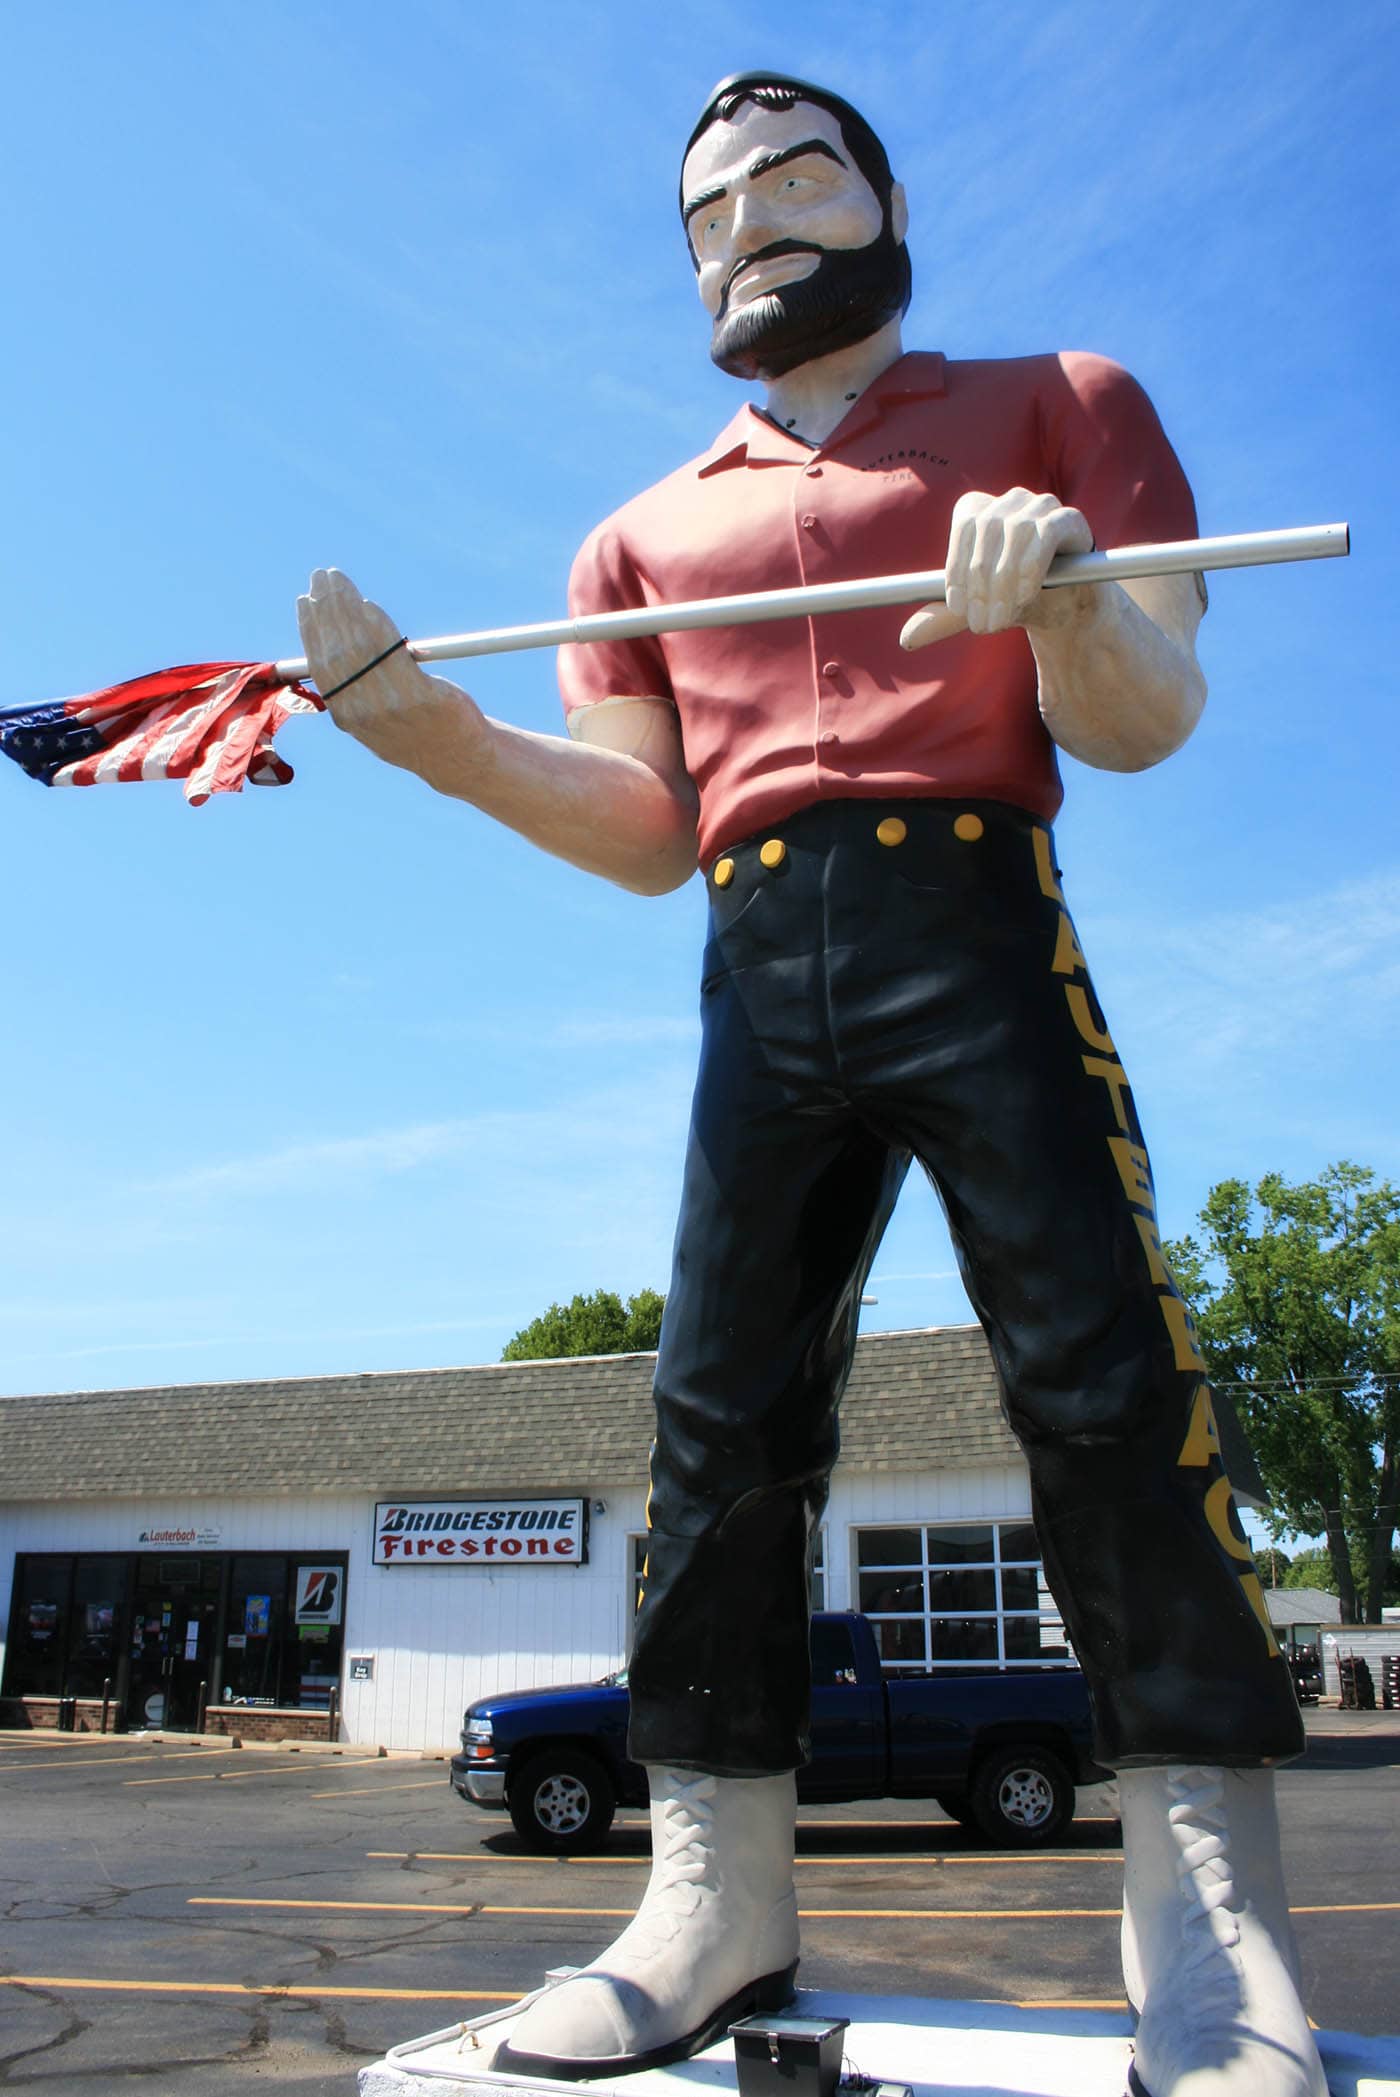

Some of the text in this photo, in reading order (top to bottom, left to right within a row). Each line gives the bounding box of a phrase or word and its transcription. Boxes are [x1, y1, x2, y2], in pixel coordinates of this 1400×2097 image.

[854, 448, 950, 478] UTERBACH
[380, 1508, 577, 1532] BRIDGESTONE
[150, 1527, 196, 1542] Lauterbach
[379, 1535, 575, 1559] Firestone
